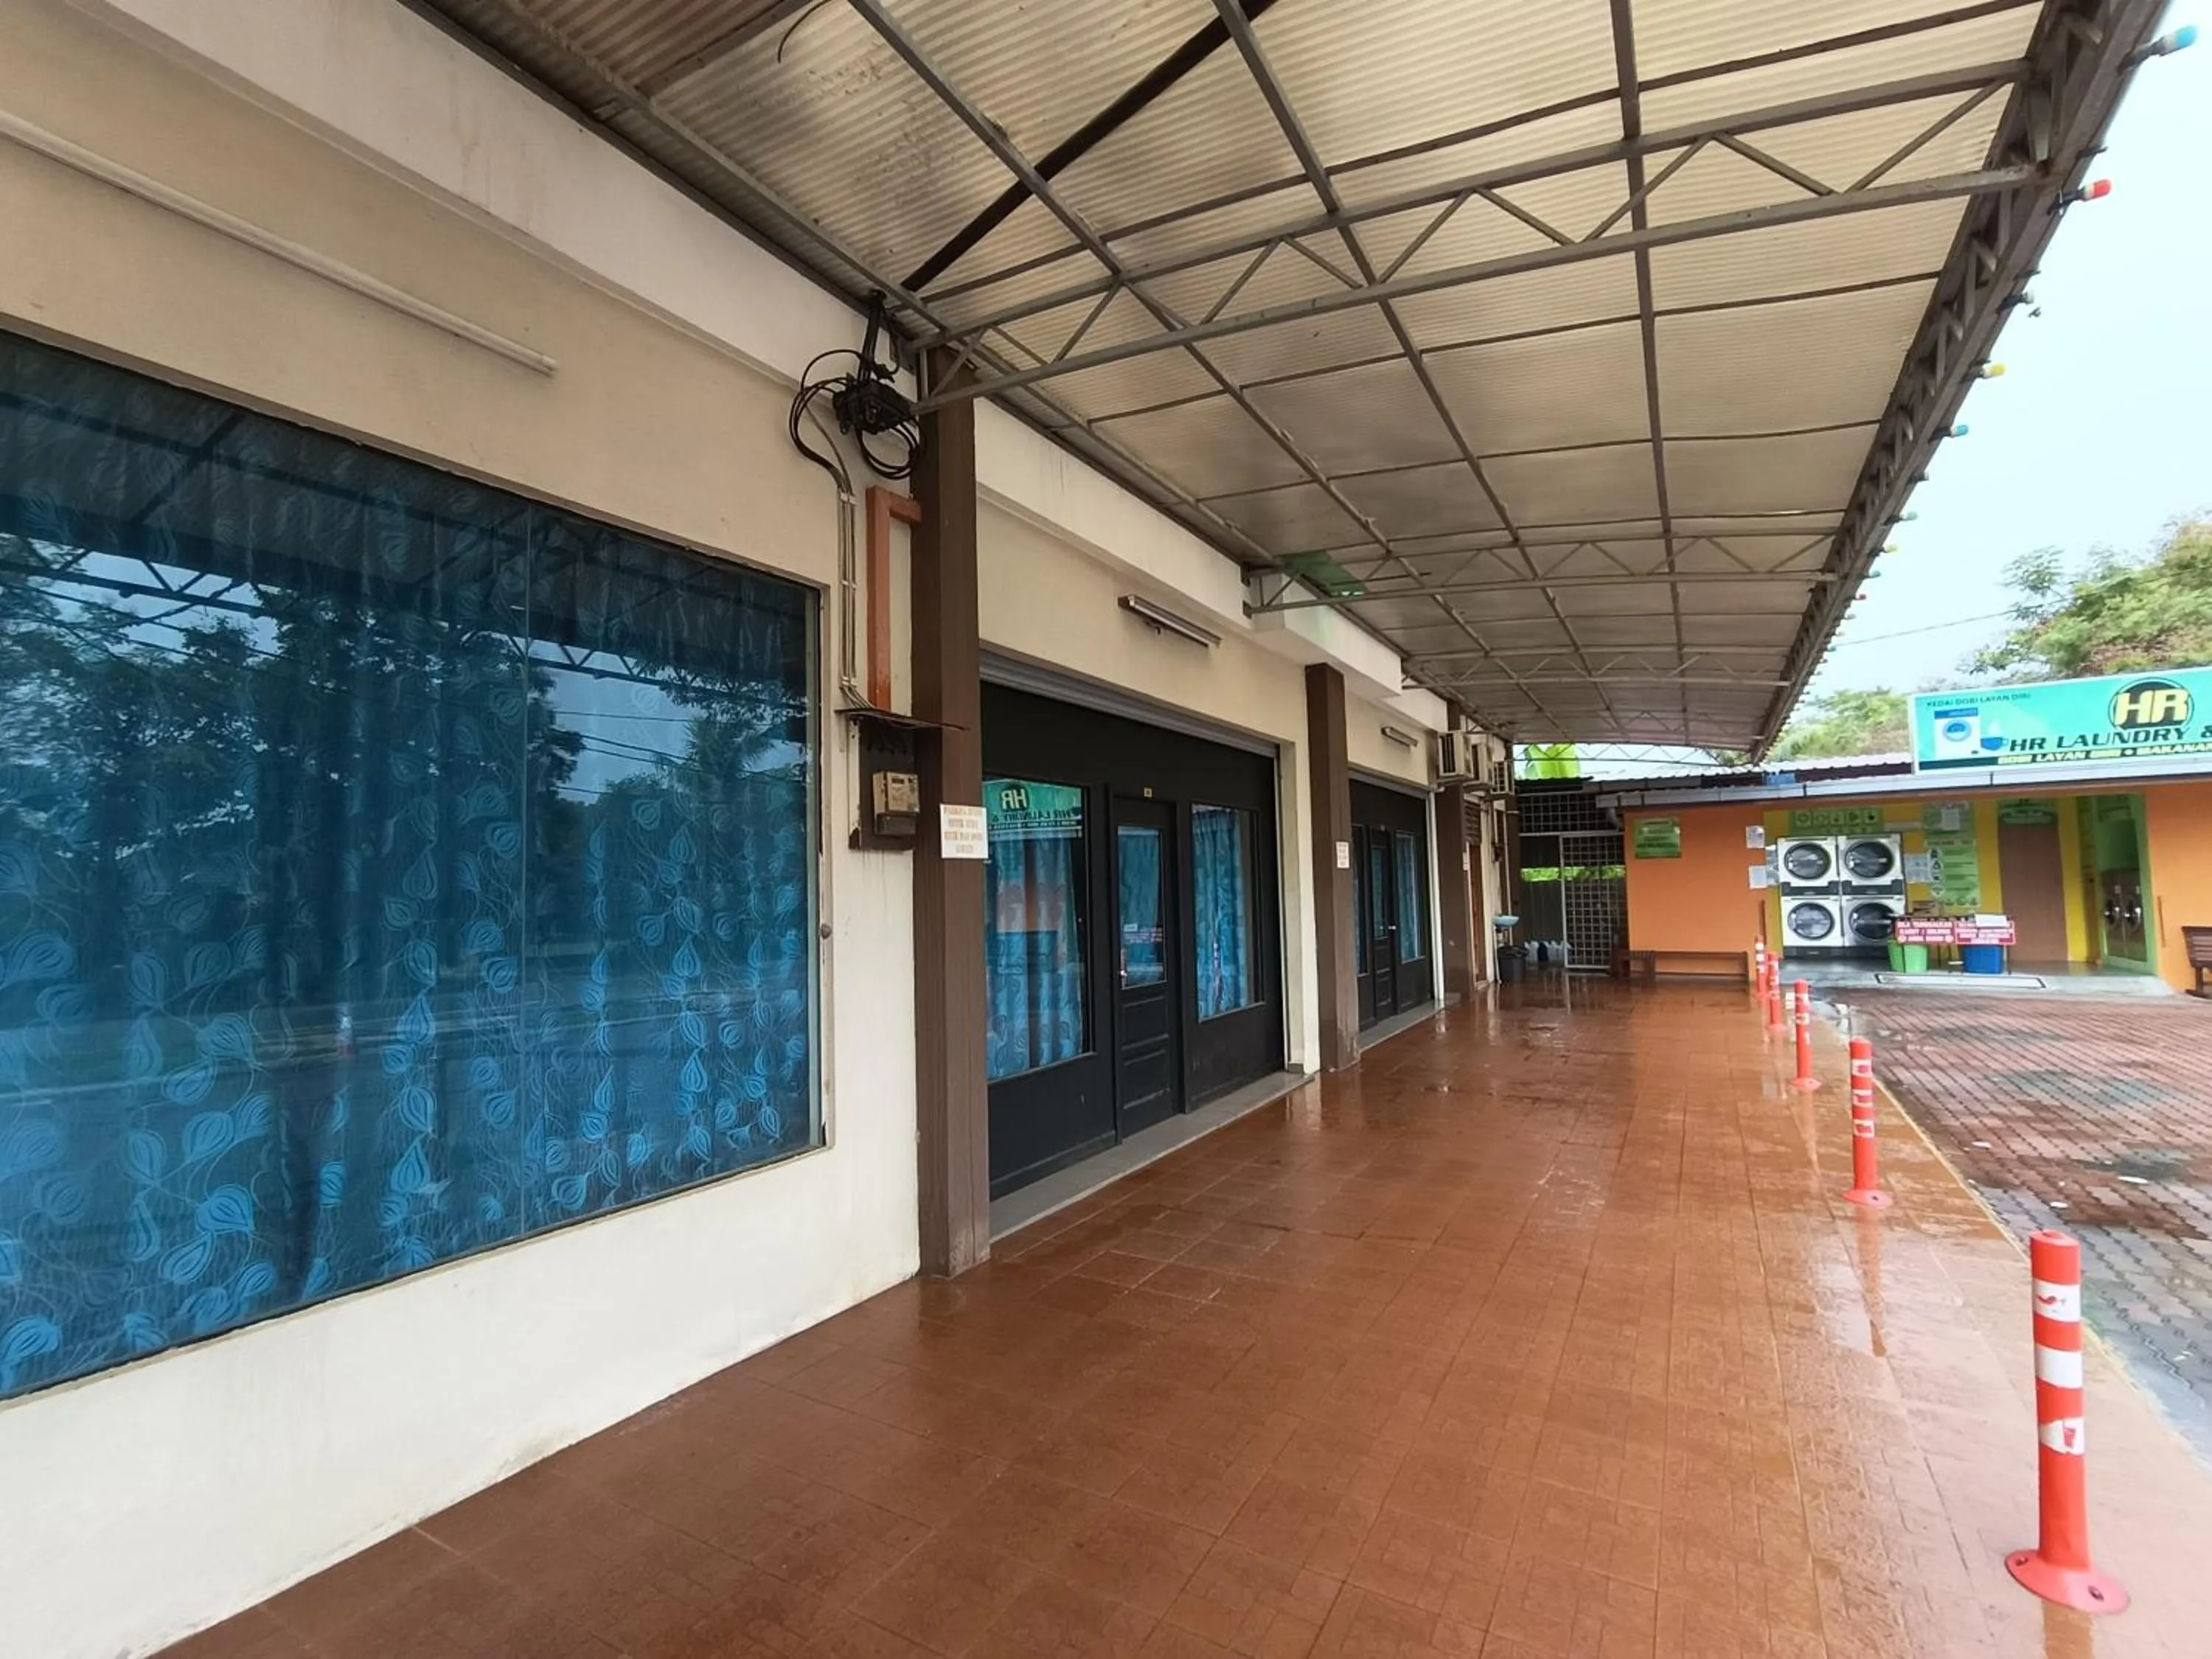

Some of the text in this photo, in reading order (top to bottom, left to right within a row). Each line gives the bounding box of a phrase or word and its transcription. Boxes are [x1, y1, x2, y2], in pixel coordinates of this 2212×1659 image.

[1980, 695, 2009, 703] LAYAN
[2114, 688, 2190, 726] HR
[2009, 738, 2046, 751] HR
[2056, 726, 2192, 748] LAUNDRY
[2035, 751, 2087, 762] LAYAN
